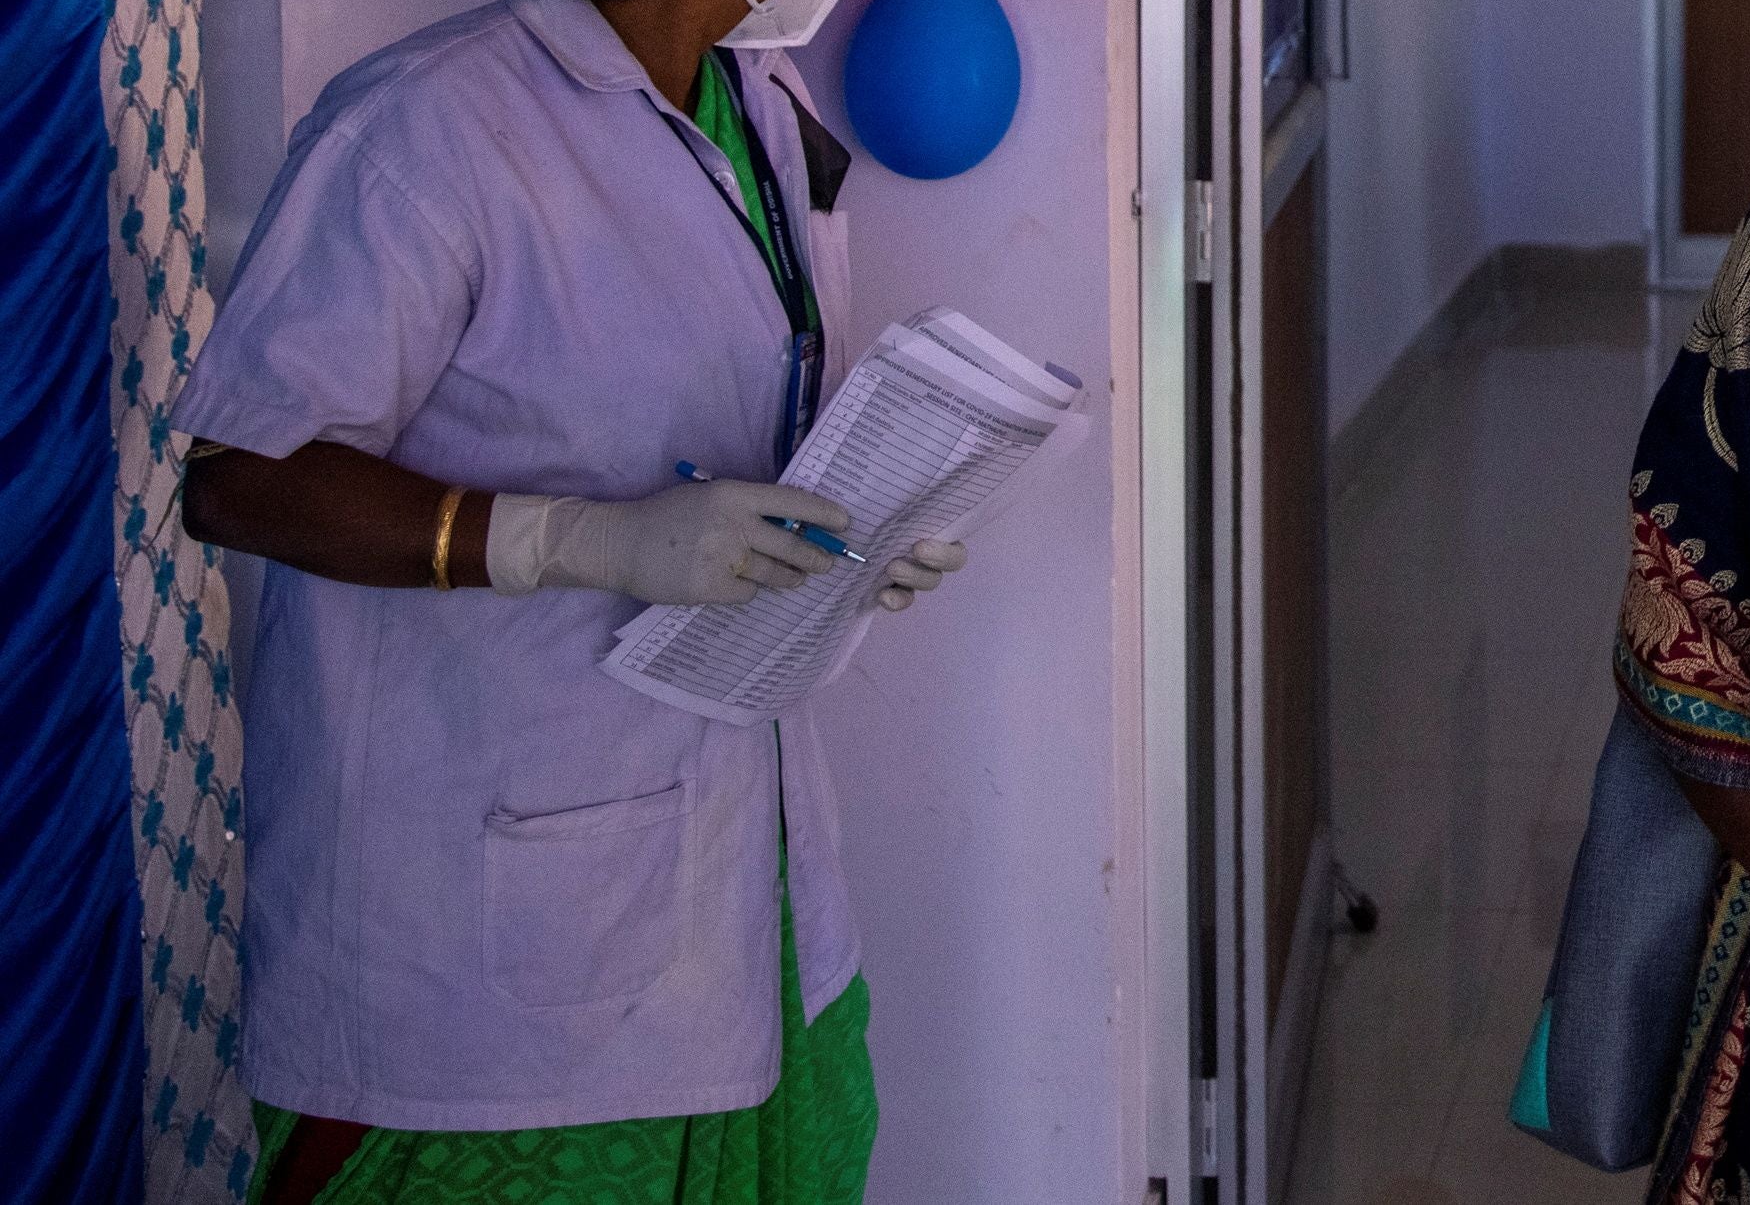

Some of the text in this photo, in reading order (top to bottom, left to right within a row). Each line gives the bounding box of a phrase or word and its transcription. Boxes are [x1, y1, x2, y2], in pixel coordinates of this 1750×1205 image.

[905, 369, 942, 393] BENEFICIARY
[941, 389, 955, 400] LIST
[953, 394, 967, 407] FOR
[925, 392, 950, 408] SESSION
